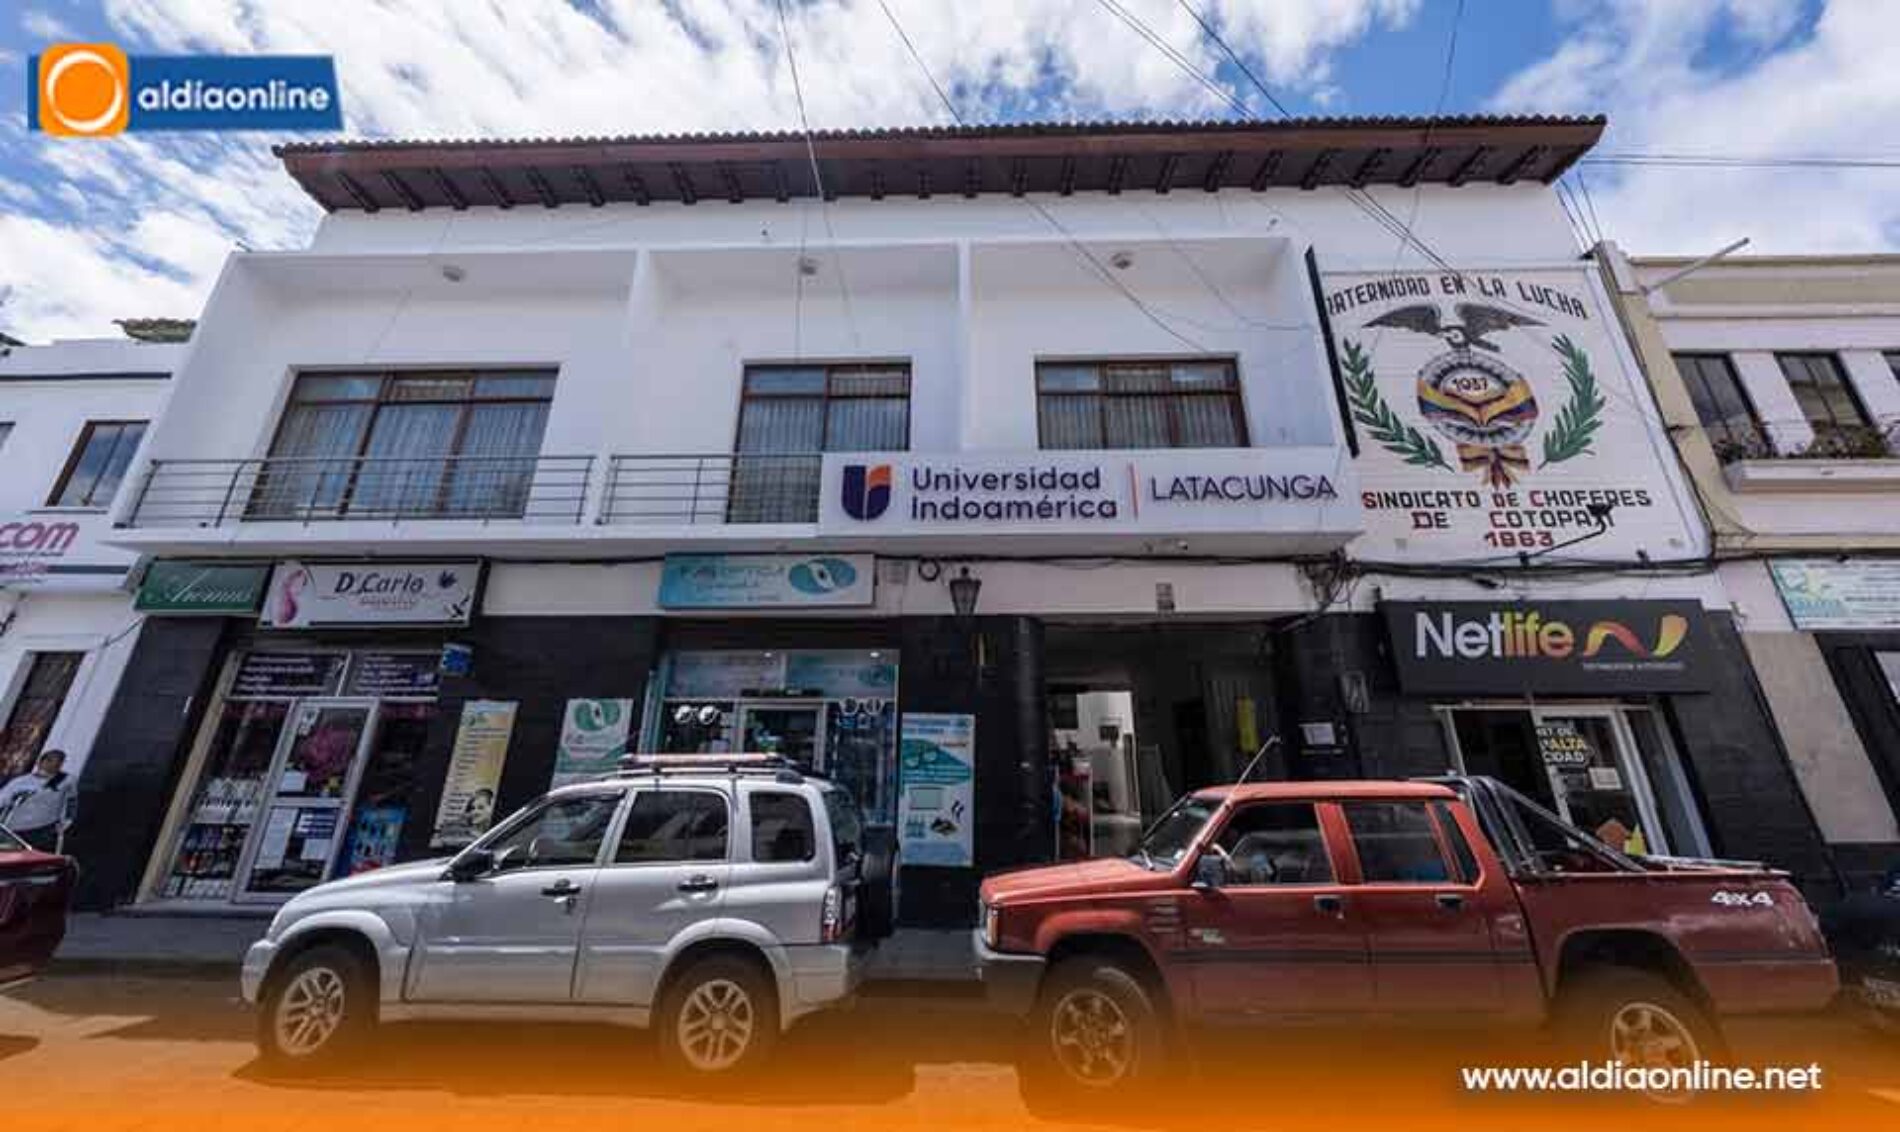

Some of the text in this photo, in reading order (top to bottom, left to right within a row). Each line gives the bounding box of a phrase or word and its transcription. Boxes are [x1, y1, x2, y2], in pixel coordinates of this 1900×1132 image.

[1440, 275, 1466, 295] EN
[1479, 276, 1507, 298] LA
[1518, 281, 1589, 320] LUCHA
[912, 466, 1101, 491] Universidad
[1150, 474, 1339, 501] LATACUNGA
[911, 495, 1117, 521] Indoamérica
[1362, 490, 1652, 509] SINDICATO DE CHOFERES
[1411, 511, 1450, 530] DE
[1415, 611, 1575, 659] Netlife
